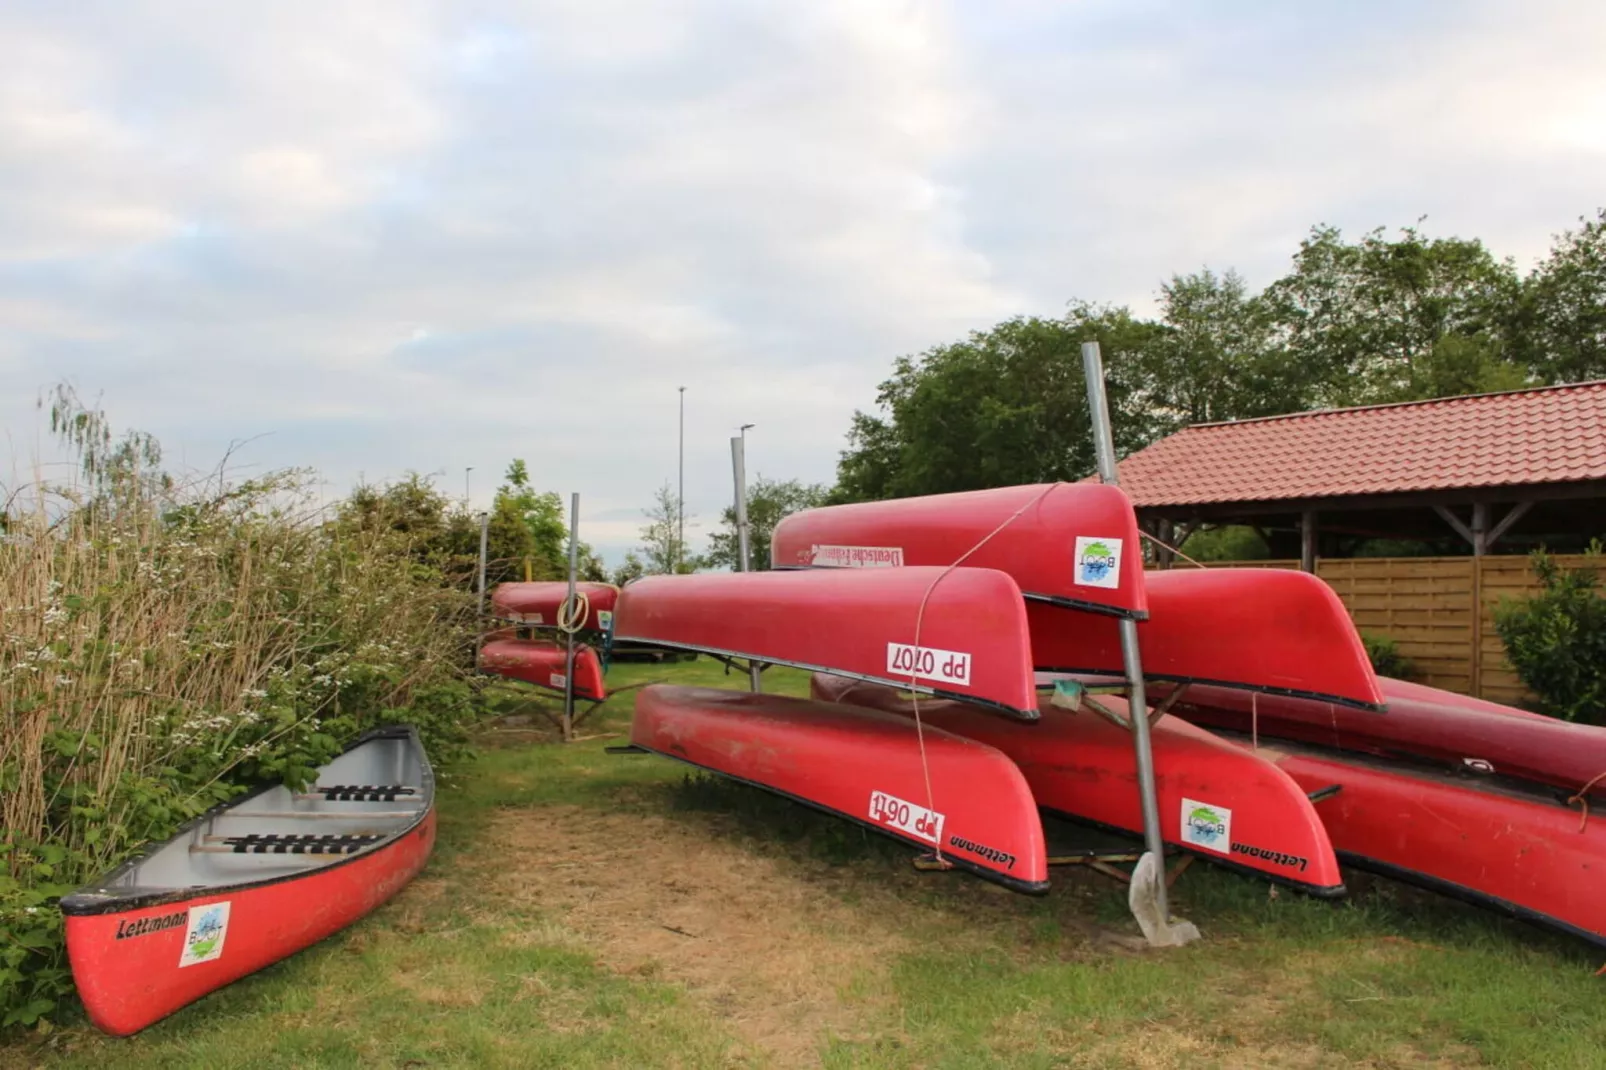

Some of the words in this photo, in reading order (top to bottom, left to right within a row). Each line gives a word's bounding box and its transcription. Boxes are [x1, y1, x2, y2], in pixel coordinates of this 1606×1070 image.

[852, 549, 900, 568] Deutsche
[892, 647, 934, 674] 0707
[942, 654, 966, 679] PP
[950, 836, 1016, 869] Lettmann
[1230, 841, 1308, 872] Lettmann
[115, 911, 188, 940] Lettmann
